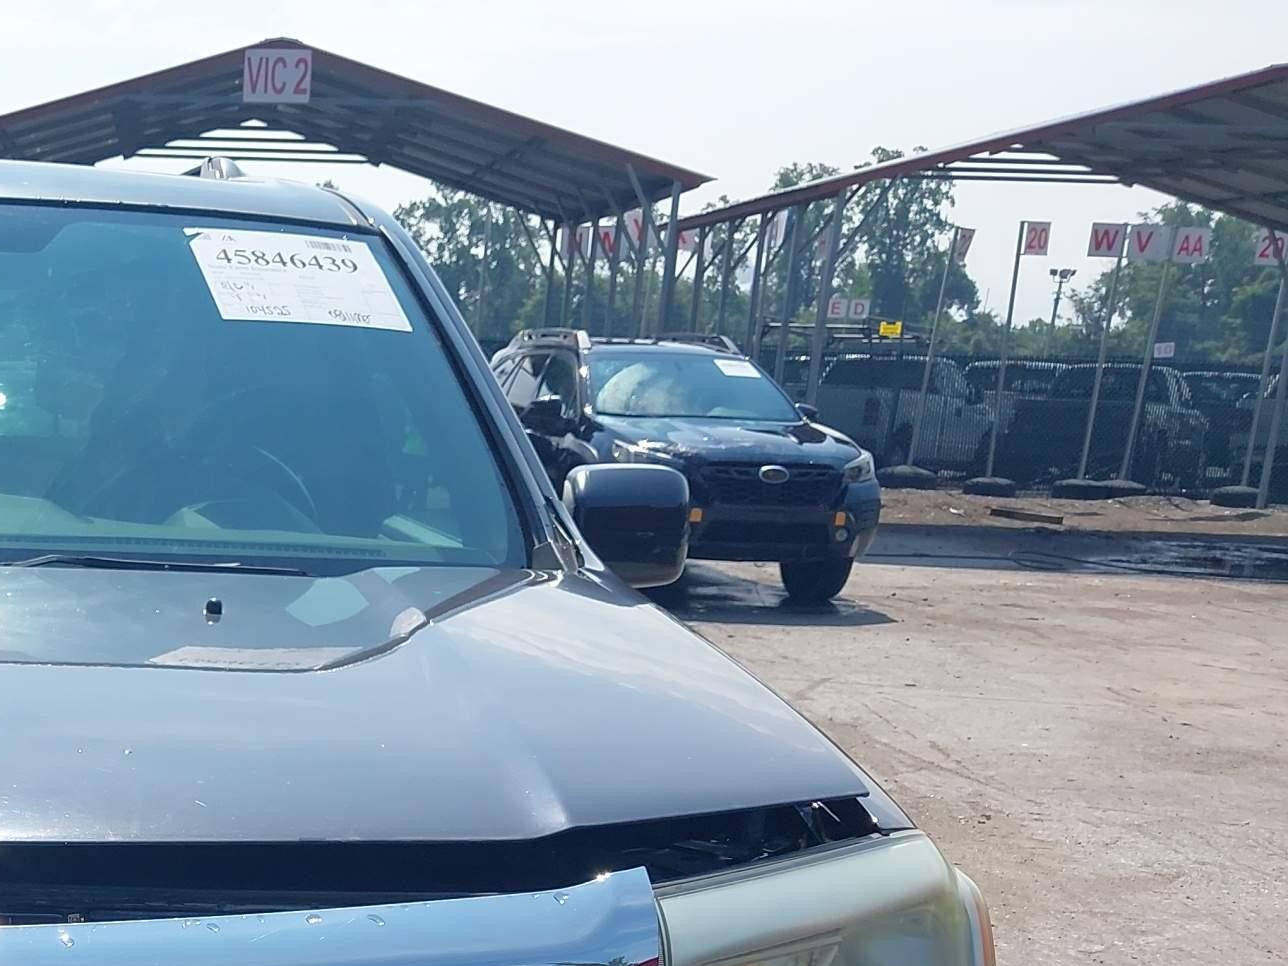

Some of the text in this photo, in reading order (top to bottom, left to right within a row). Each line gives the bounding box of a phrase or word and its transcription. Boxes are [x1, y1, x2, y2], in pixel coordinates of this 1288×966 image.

[247, 56, 308, 95] VIC 2
[1027, 227, 1047, 250] 20
[1094, 229, 1119, 251] W
[1136, 231, 1153, 253] V
[1177, 234, 1203, 256] AA
[215, 247, 358, 274] 45846439
[831, 302, 841, 315] E
[854, 302, 865, 315] D
